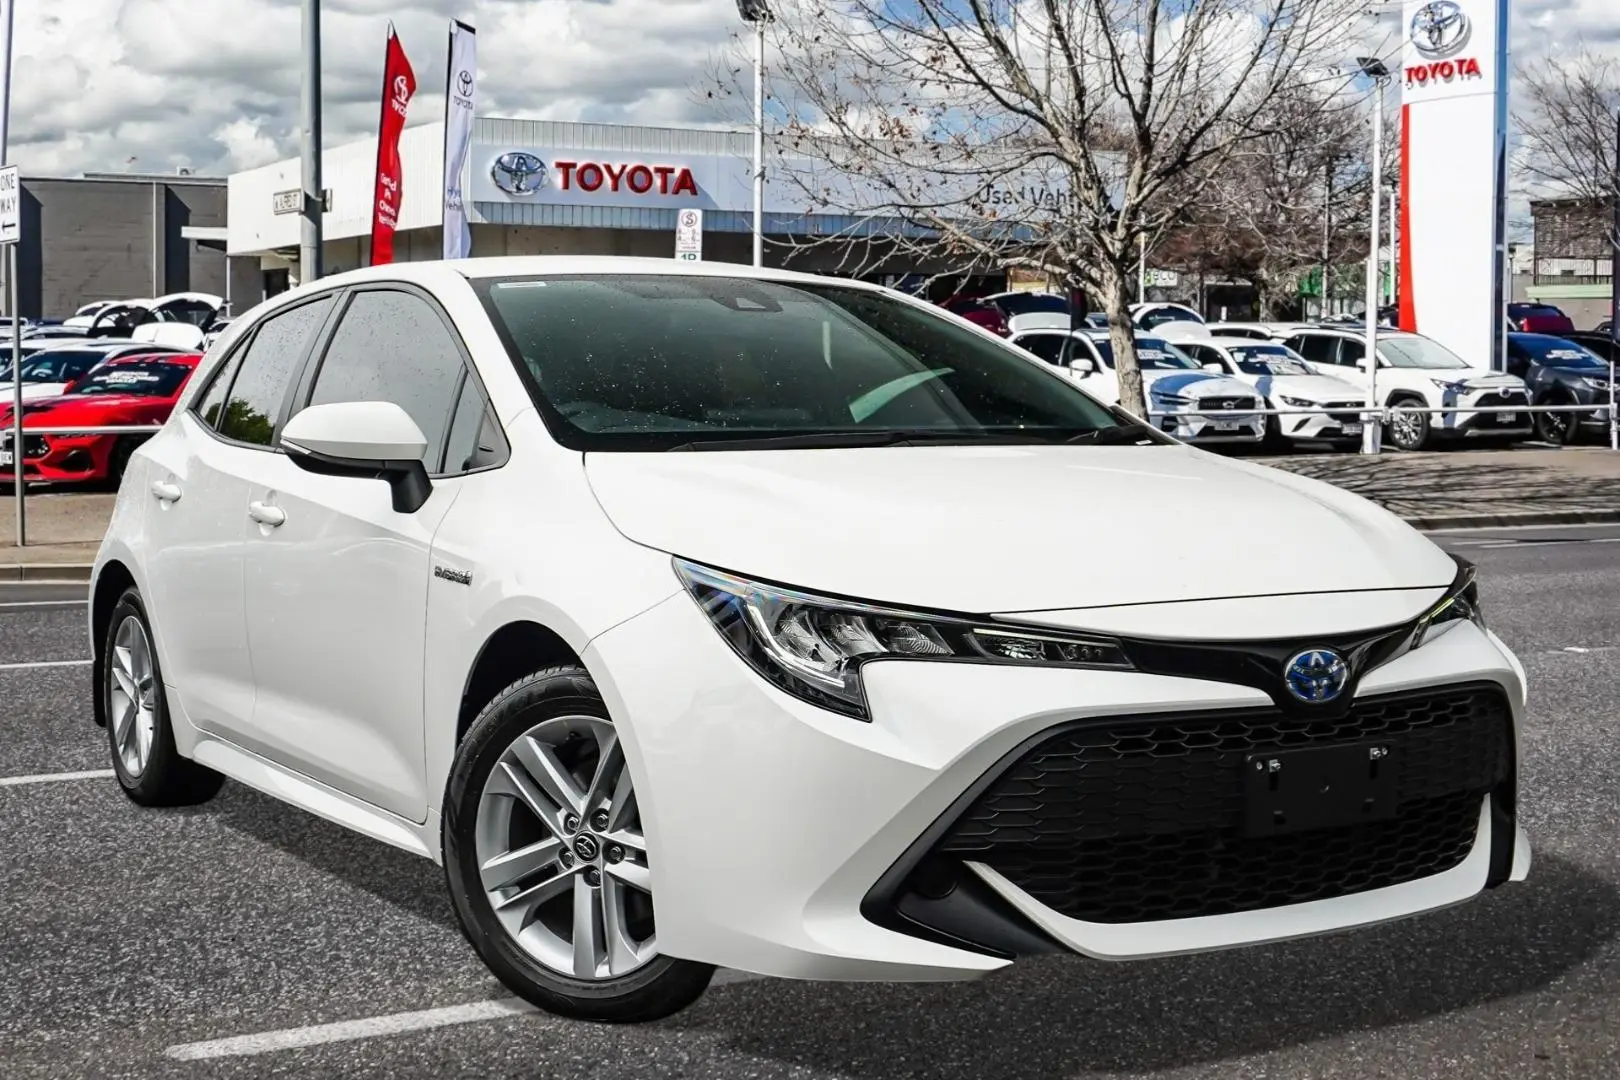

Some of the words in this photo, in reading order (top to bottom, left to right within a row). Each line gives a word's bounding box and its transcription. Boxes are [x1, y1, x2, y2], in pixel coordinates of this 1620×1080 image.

[1404, 58, 1480, 83] TOYOTA
[0, 173, 15, 191] ONE
[555, 161, 698, 196] TOYOTA
[0, 196, 16, 214] WAY
